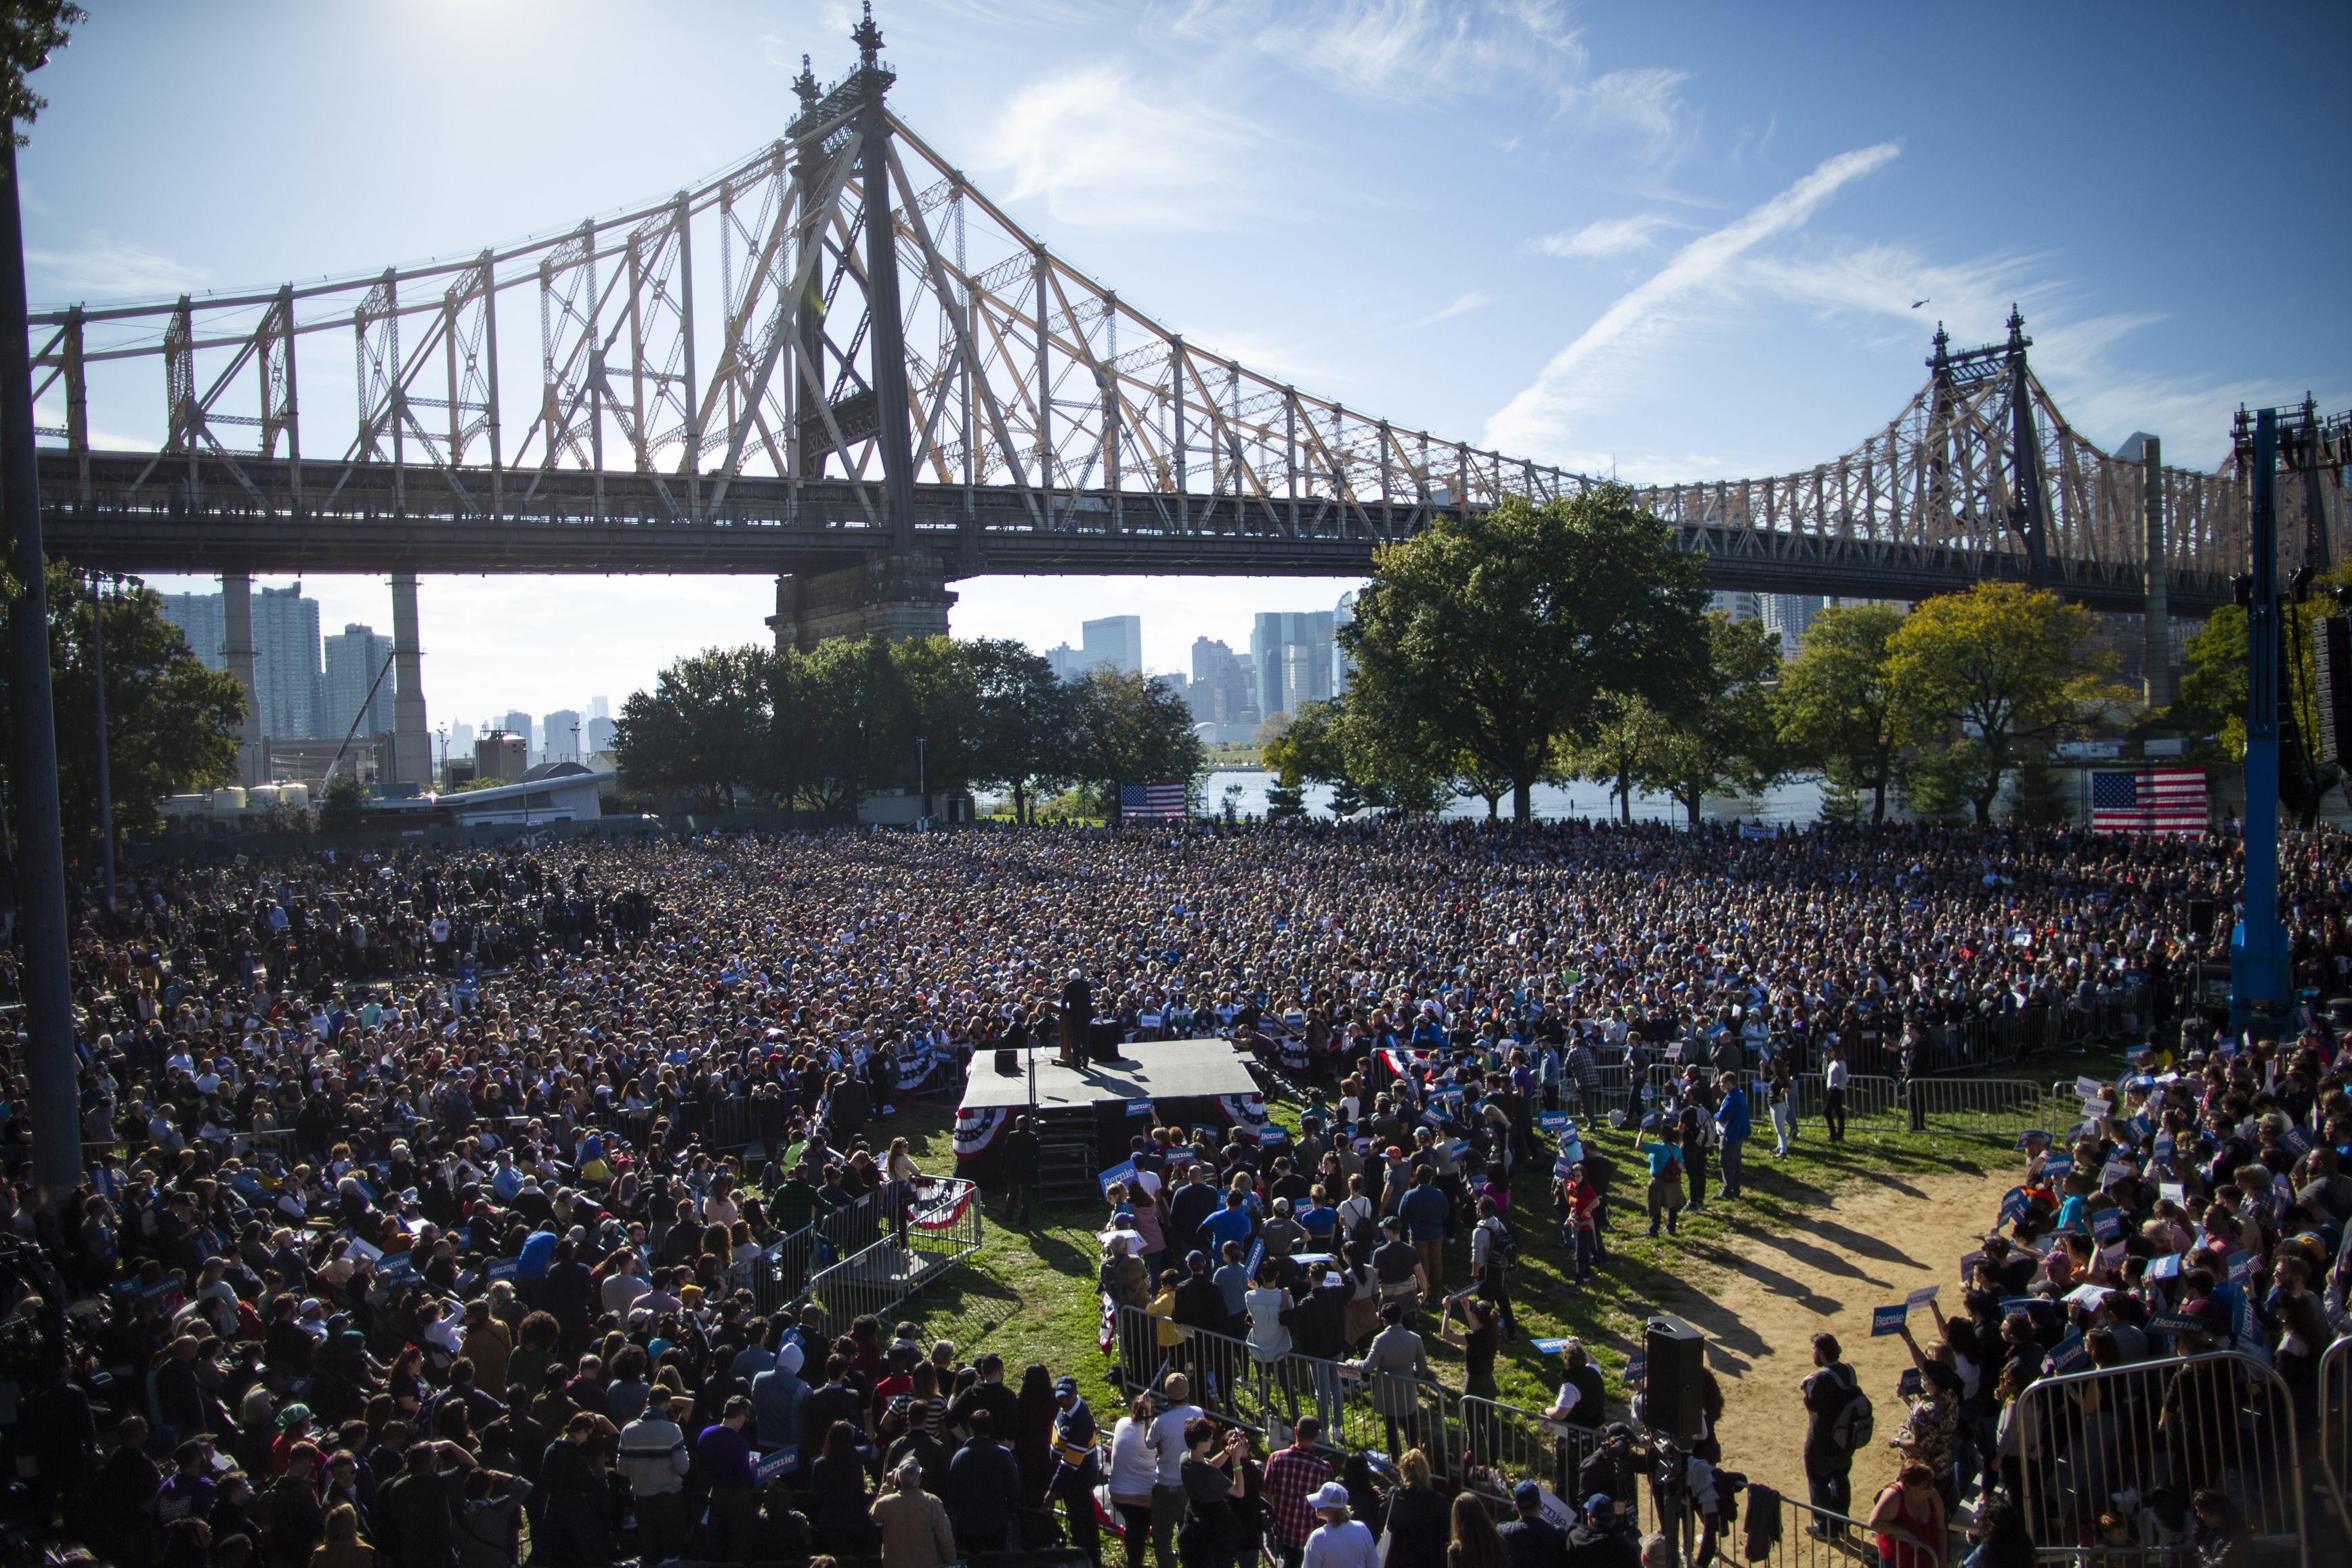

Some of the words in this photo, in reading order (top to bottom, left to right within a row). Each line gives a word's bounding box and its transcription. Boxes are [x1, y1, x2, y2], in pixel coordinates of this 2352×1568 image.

[1742, 826, 1774, 835] Bernie
[2085, 1104, 2105, 1112] Bernie
[1542, 1116, 1566, 1124] Bernie
[1260, 1131, 1285, 1140] Bernie
[2288, 1131, 2311, 1154] Bern
[1168, 1151, 1193, 1159] Bernie
[2045, 1159, 2070, 1169] Bernie
[1103, 1168, 1134, 1186] Bernie
[2162, 1192, 2181, 1201] Bernie
[1296, 1203, 1313, 1212] Bern
[2093, 1217, 2117, 1231] Bernie
[2106, 1253, 2126, 1267] Bern
[2004, 1305, 2028, 1315] Bern
[1875, 1312, 1904, 1326] Bernie
[2152, 1317, 2203, 1332] Bernie
[2055, 1343, 2083, 1368] Bernie
[757, 1454, 795, 1478] Bernie
[1541, 1502, 1566, 1526] rnie
